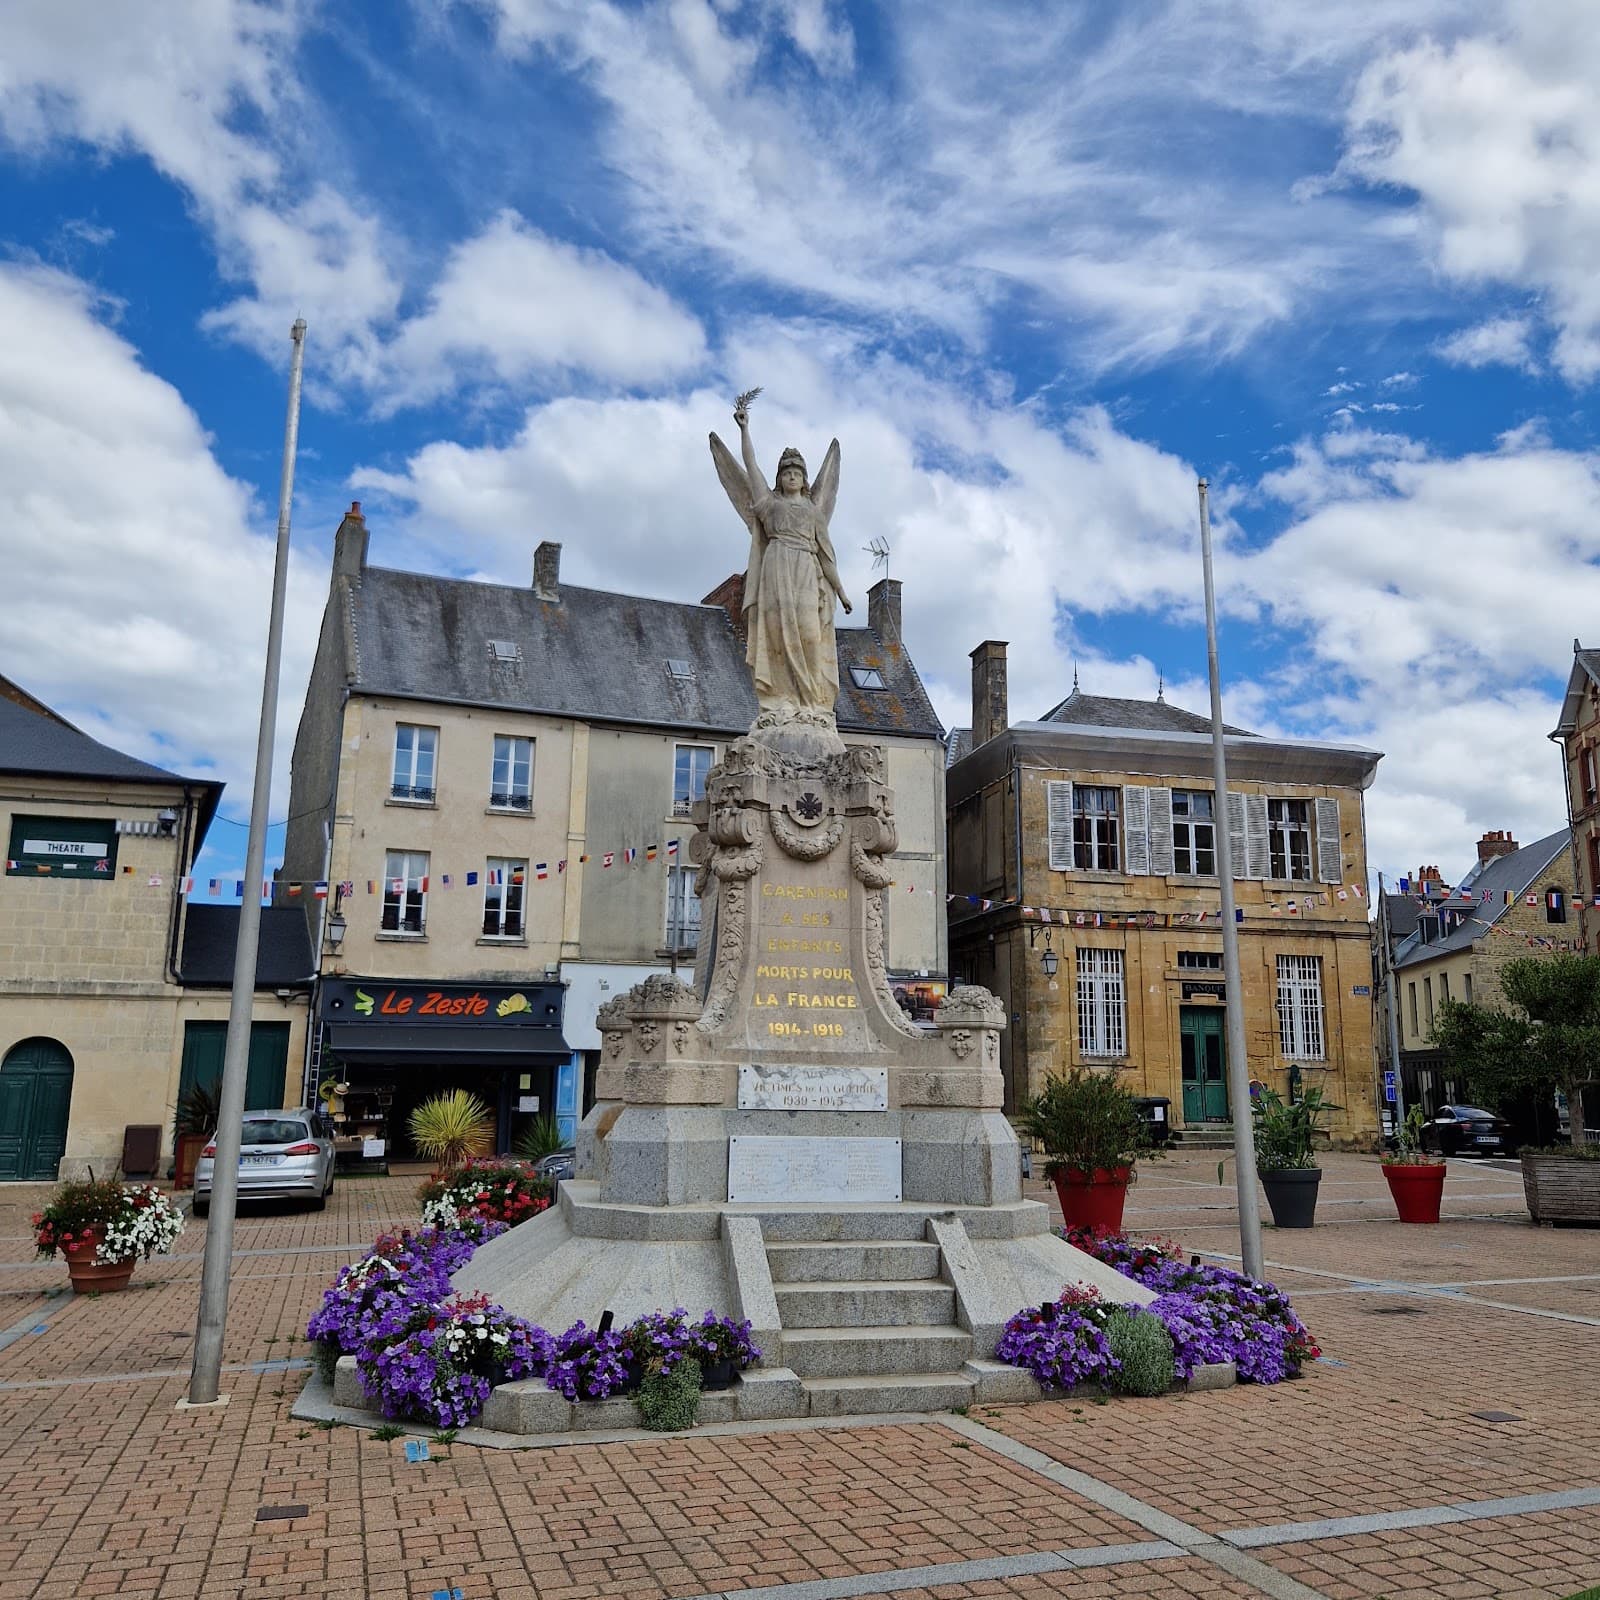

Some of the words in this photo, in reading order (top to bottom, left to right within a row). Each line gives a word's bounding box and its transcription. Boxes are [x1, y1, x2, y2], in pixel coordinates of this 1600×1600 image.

[47, 843, 85, 853] THEATRE
[762, 883, 848, 900] CARENTAN
[802, 912, 831, 925] SES
[767, 938, 842, 953] ENFANTS
[757, 966, 808, 980] MORTS
[812, 967, 854, 983] POUR
[1185, 984, 1224, 993] BANQUE
[381, 990, 413, 1013] Le
[417, 992, 489, 1015] Zeste
[755, 992, 779, 1006] LA
[787, 991, 857, 1008] FRANCE
